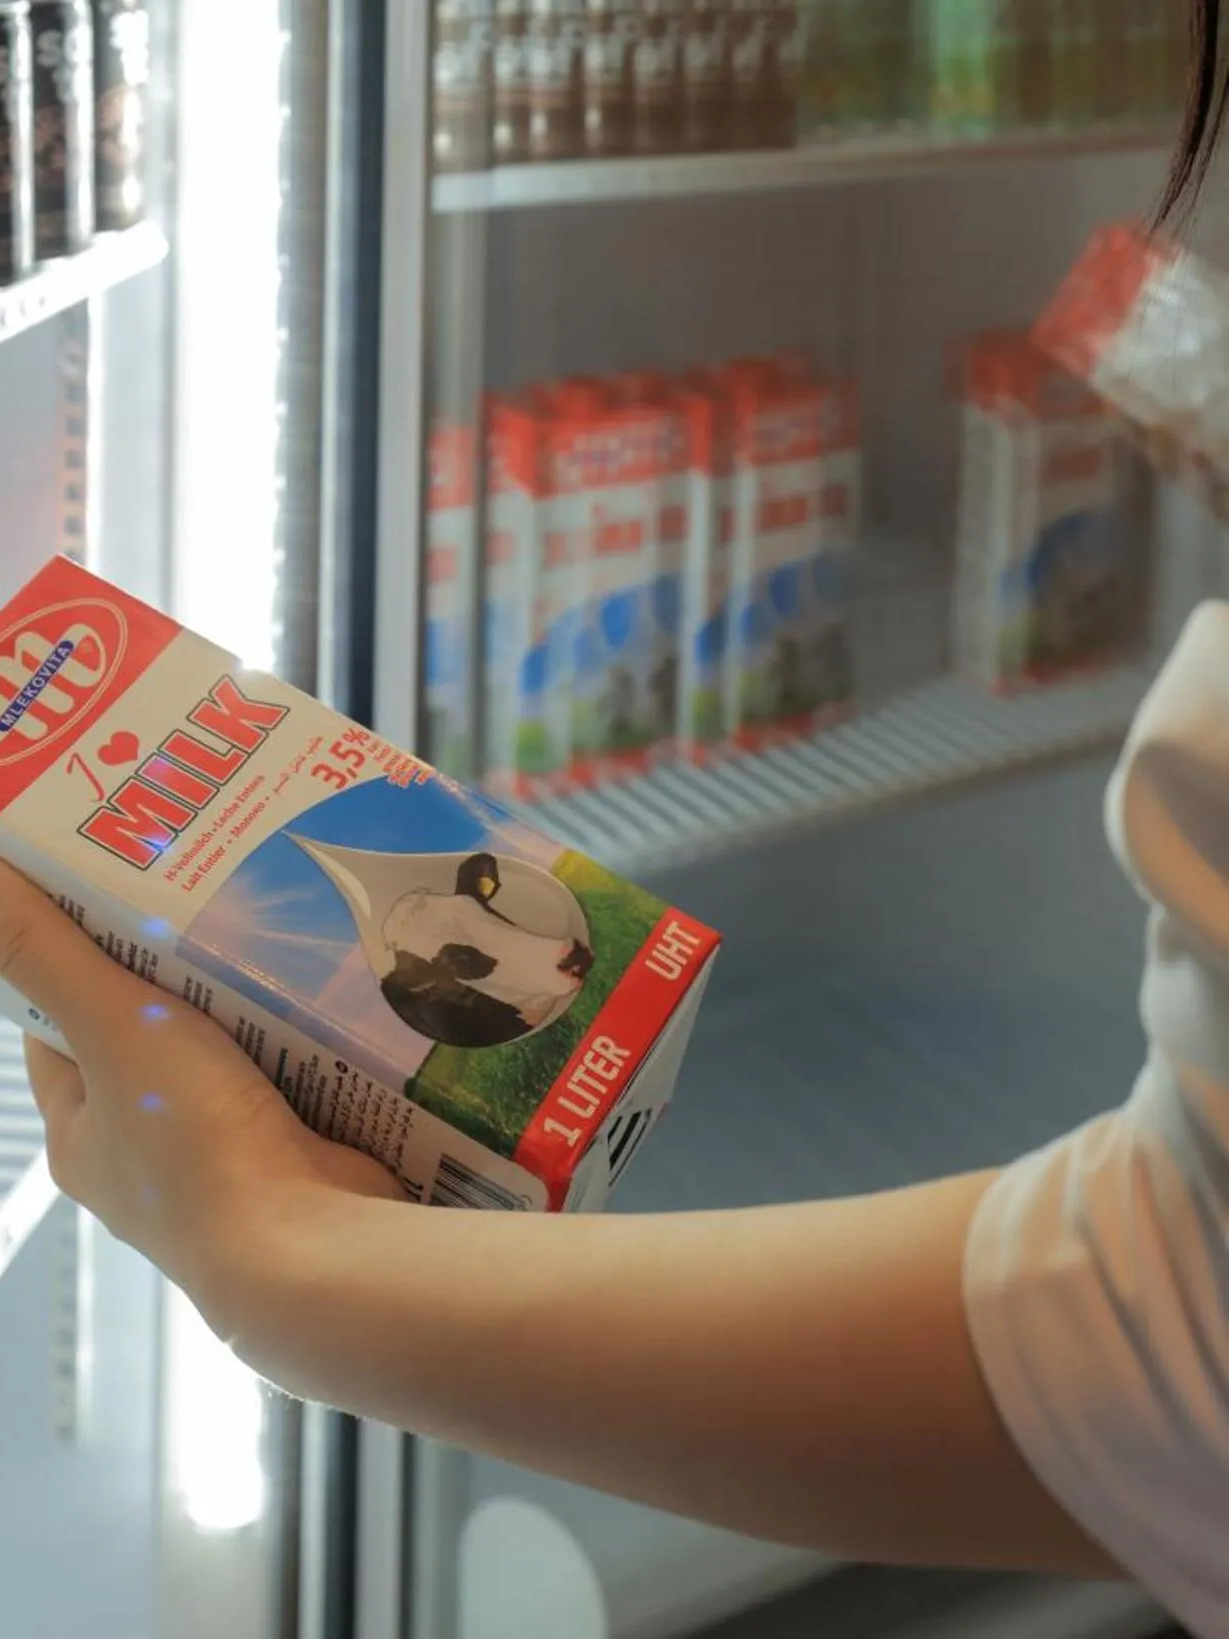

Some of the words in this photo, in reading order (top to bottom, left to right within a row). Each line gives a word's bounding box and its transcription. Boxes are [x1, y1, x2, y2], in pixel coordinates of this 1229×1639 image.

[0, 643, 71, 729] MLEKOVITA
[76, 673, 291, 871] MILK
[311, 726, 371, 789] 3,5%
[181, 869, 203, 892] Lait
[199, 845, 227, 875] Entier
[645, 920, 702, 981] UHT
[557, 1034, 632, 1121] LITER
[543, 1114, 582, 1148] 1
